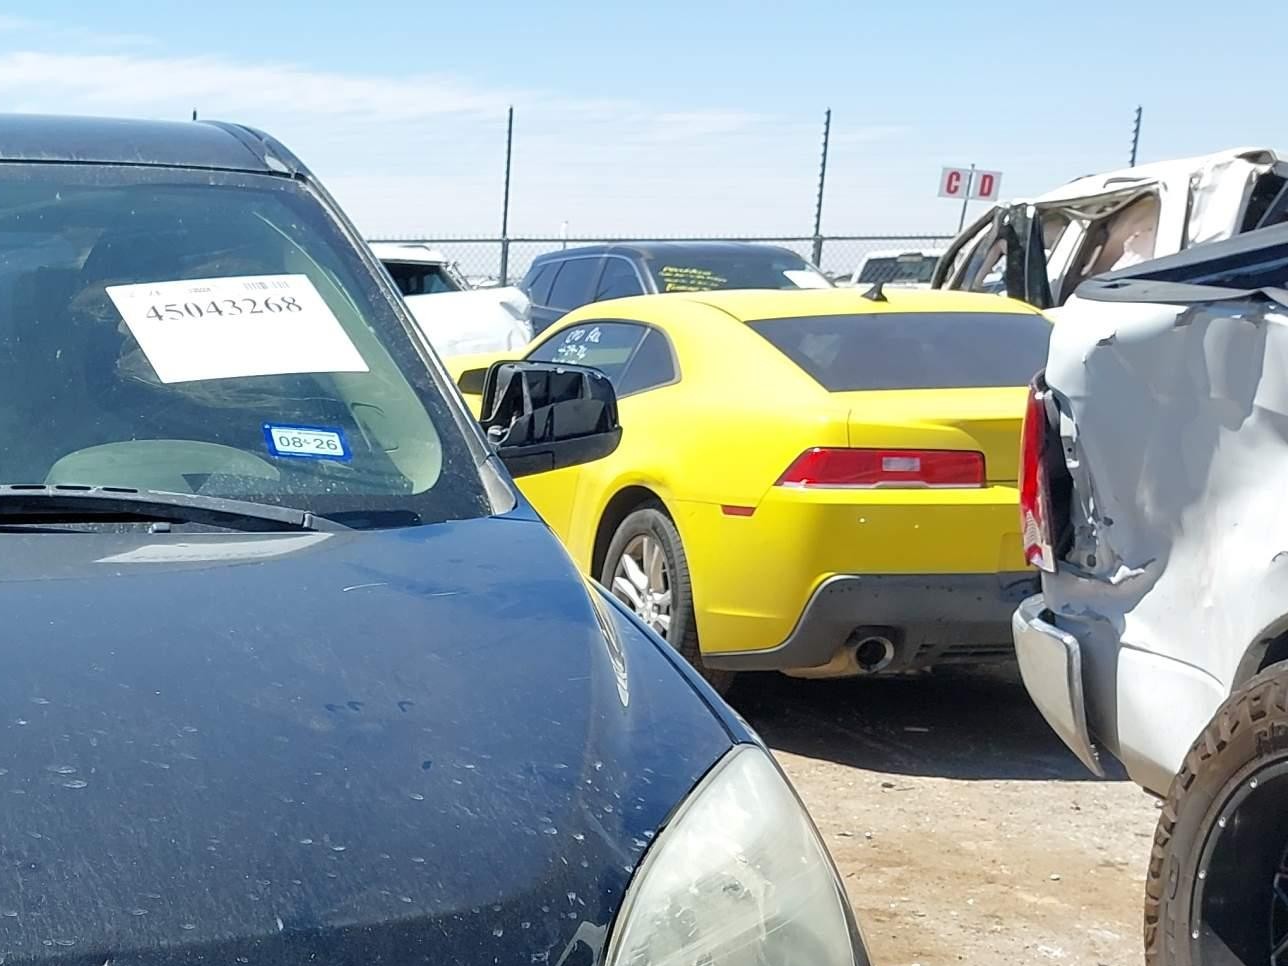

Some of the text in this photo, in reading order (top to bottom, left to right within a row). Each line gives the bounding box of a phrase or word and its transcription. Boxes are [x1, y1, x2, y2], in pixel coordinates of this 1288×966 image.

[946, 171, 961, 194] C
[978, 174, 994, 197] D
[146, 296, 303, 321] 45043268
[279, 436, 338, 450] 08 26
